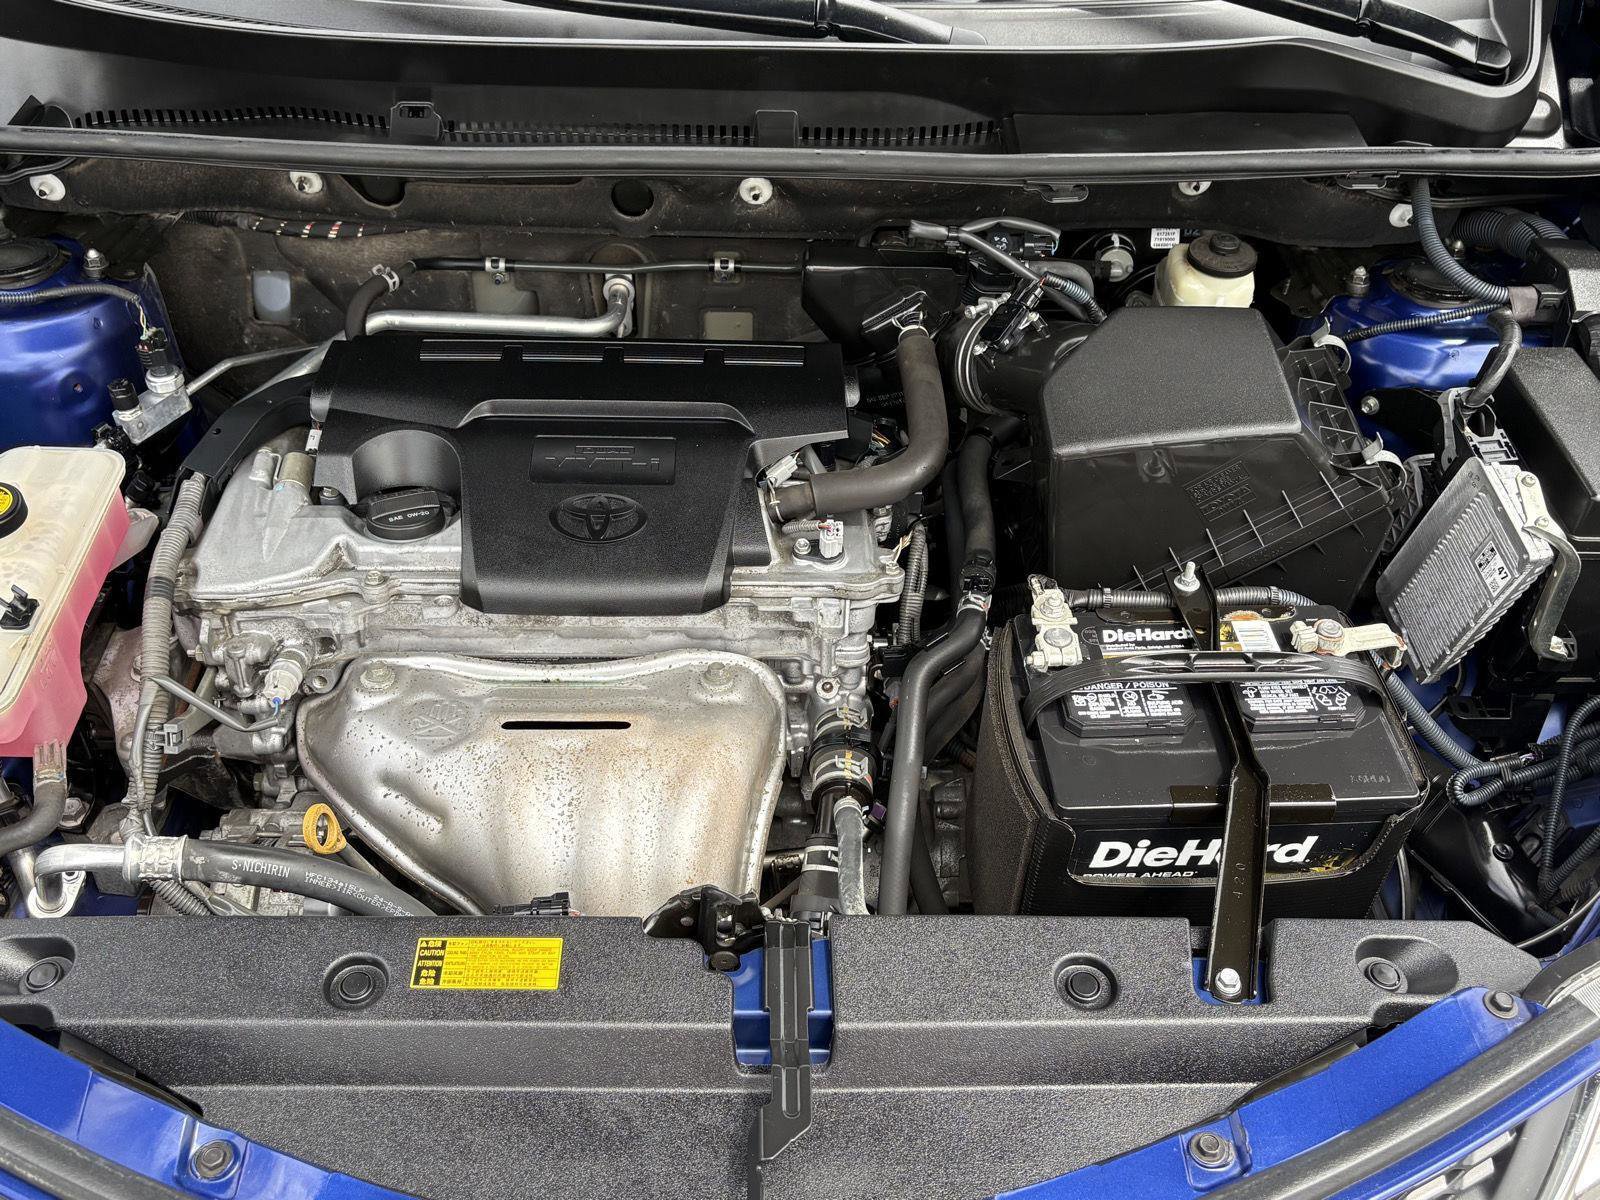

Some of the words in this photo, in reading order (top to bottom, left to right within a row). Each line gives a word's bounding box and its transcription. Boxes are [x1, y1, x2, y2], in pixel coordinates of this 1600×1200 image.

[388, 515, 404, 523] SAE
[407, 510, 430, 518] 0W-20
[1102, 627, 1188, 643] DieHard
[1088, 835, 1319, 868] DieHrd
